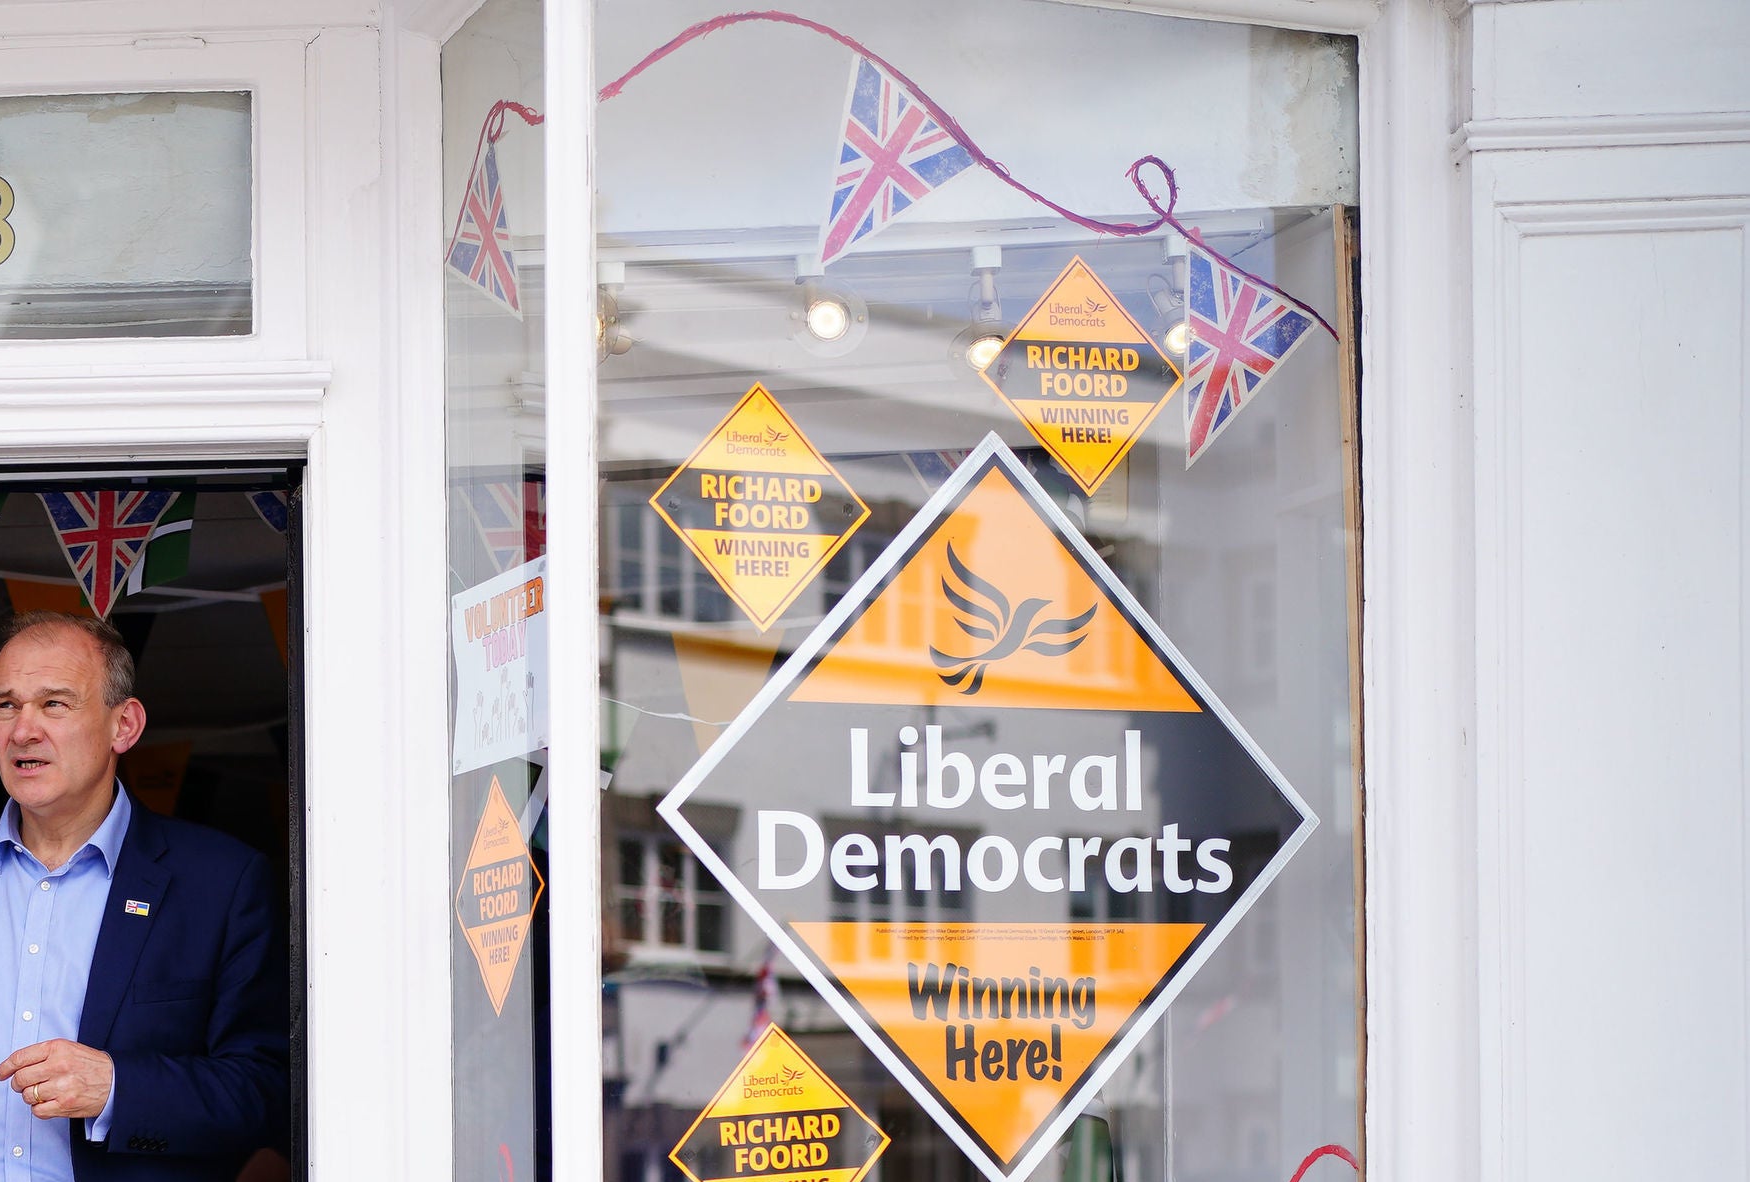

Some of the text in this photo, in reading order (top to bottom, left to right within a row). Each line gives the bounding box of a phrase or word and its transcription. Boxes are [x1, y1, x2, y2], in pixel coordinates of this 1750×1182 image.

[1048, 302, 1084, 315] Liberal
[1049, 314, 1105, 328] Democrats
[1026, 344, 1139, 373] RICHARD
[1039, 371, 1128, 398] FOORD
[1039, 406, 1129, 426] WINNING
[725, 430, 763, 444] Liberal
[1061, 425, 1112, 444] HERE!
[726, 442, 787, 457] Democrats
[701, 472, 822, 503] RICHARD
[715, 500, 809, 530] FOORD
[714, 538, 810, 559] WINNING
[735, 558, 790, 577] HERE!
[464, 576, 544, 643] VOLUNTEER
[482, 620, 526, 672] TODAY
[849, 724, 1143, 811] Liberal
[757, 808, 1234, 894] Democrats
[473, 861, 523, 896] RICHARD
[480, 889, 518, 921] FOORD
[480, 924, 518, 948] WINNING
[489, 946, 510, 966] HERE!
[906, 961, 1096, 1029] Winning
[944, 1023, 1063, 1083] Here!
[742, 1073, 780, 1087] Liberal
[743, 1082, 804, 1098] Democrats
[719, 1113, 841, 1147] RICHARD
[733, 1141, 829, 1173] FOORD
